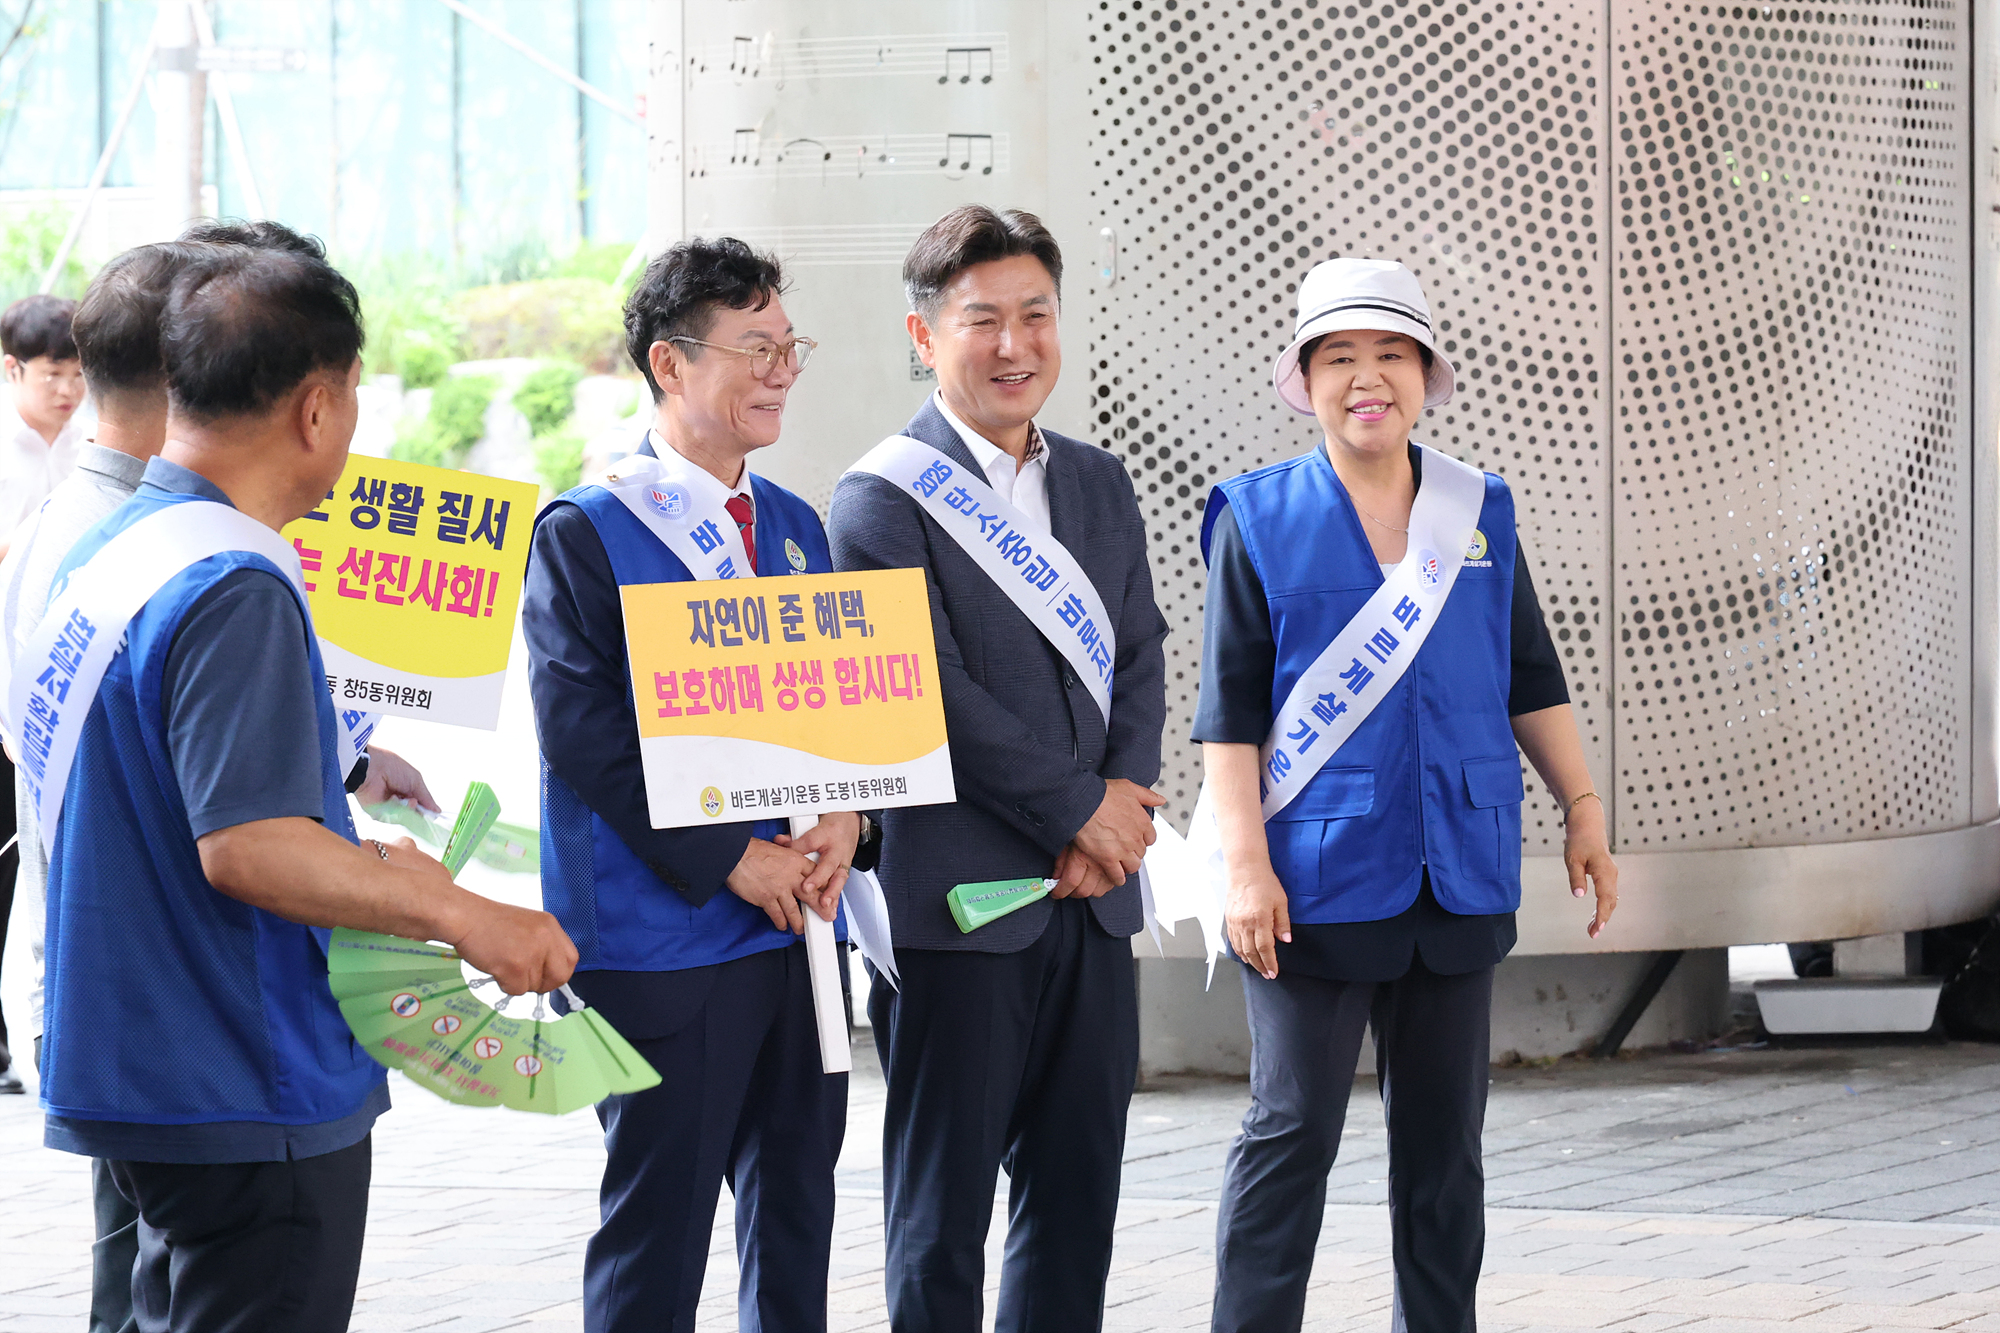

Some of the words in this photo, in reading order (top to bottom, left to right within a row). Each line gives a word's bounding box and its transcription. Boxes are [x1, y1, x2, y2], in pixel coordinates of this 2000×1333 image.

[350, 476, 425, 536] 생활
[437, 491, 511, 551] 질서
[912, 459, 953, 498] 2025
[943, 485, 1060, 592] 탄소중립
[336, 546, 500, 618] 선진사회!
[686, 595, 770, 648] 자연이
[778, 594, 806, 643] 준
[812, 589, 875, 640] 혜택,
[343, 678, 433, 709] 창5동위원회
[653, 663, 764, 718] 보호하며
[772, 659, 827, 712] 상생
[833, 653, 923, 706] 합시다!
[730, 783, 821, 810] 바르게살기운동
[825, 776, 908, 801] 도봉1동위원회
